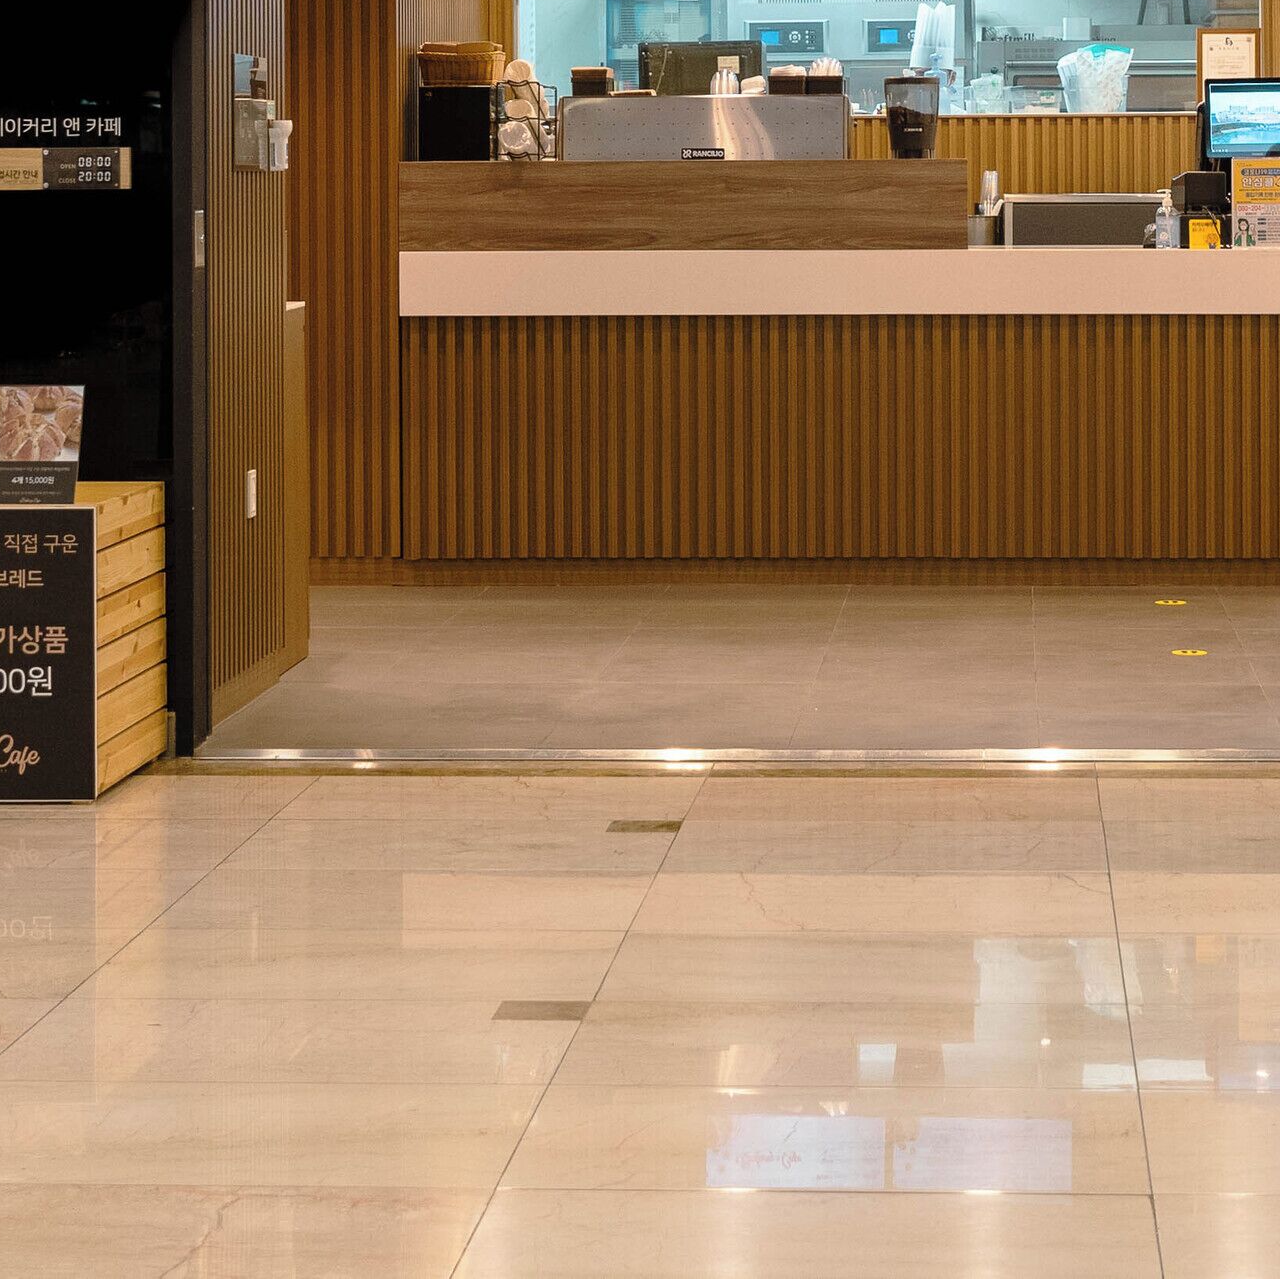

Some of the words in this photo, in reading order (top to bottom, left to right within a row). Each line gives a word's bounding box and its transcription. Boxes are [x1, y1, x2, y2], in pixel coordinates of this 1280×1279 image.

[63, 117, 81, 137] 앤
[86, 117, 122, 137] 카페
[692, 150, 724, 158] RANCILIO
[78, 156, 112, 168] 08:00
[22, 169, 39, 180] 안내
[78, 171, 112, 182] 20:00
[11, 476, 24, 485] 4개
[25, 476, 55, 485] 15,000원
[4, 533, 39, 554] 직접
[43, 533, 79, 554] 구운
